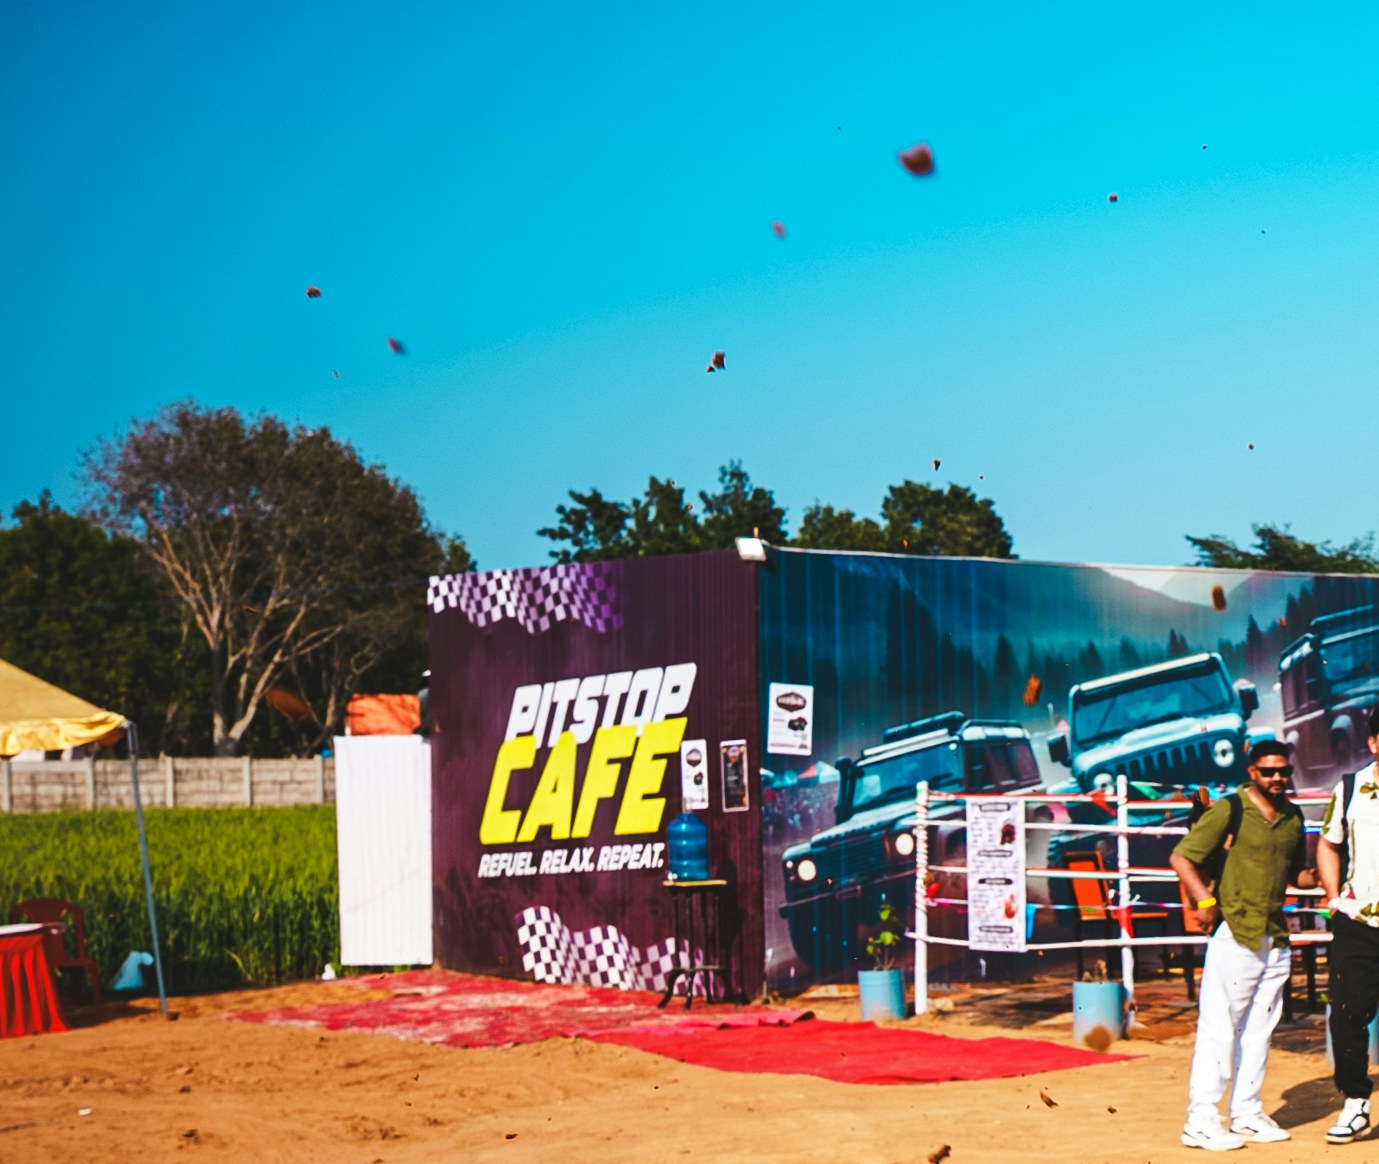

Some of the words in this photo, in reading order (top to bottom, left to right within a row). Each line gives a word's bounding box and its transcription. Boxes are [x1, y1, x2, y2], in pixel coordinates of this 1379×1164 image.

[503, 662, 697, 750] PITSTOP
[479, 716, 688, 845] CAFE
[477, 851, 538, 878] REFUEL.
[539, 847, 595, 876] RELAX.
[596, 842, 666, 872] REPEAT.
